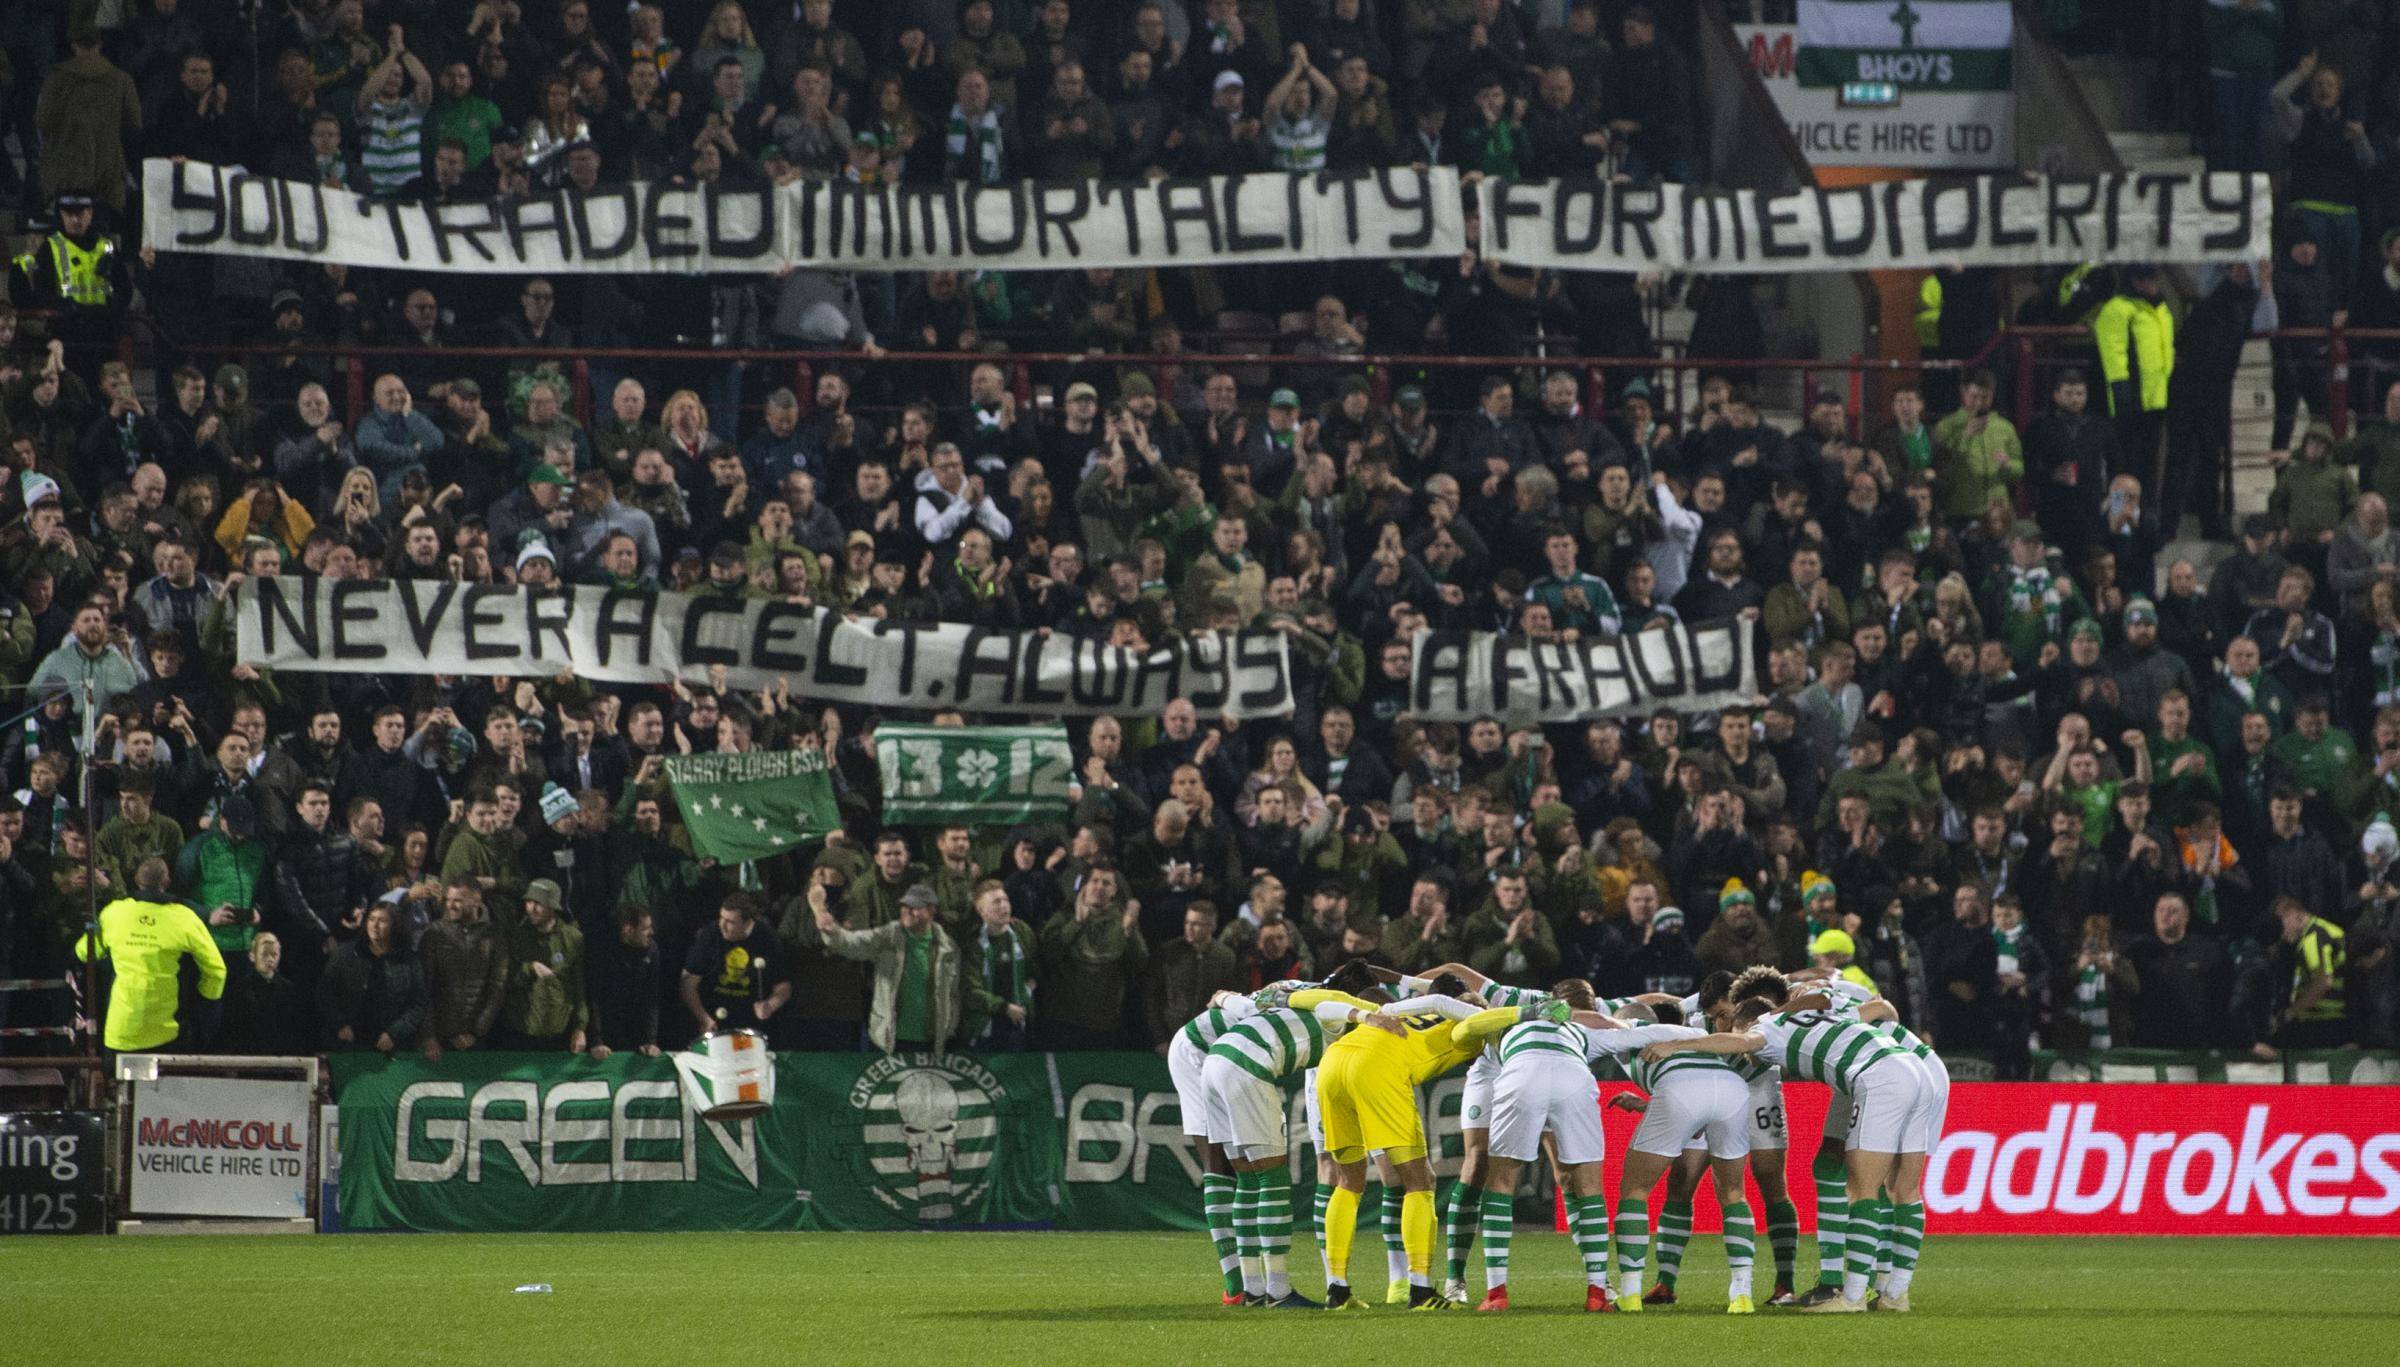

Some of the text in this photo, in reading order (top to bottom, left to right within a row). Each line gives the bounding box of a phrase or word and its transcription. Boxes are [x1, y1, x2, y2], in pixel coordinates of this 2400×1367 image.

[1858, 53, 1953, 83] BHOYS
[1797, 122, 1994, 154] ICLE HIRE LTD
[171, 162, 777, 263] YOU TRADED
[800, 166, 1435, 259] IMMORTALITY
[1490, 172, 2254, 262] FOR MEDIOCRITY
[256, 576, 575, 661] NEVER
[598, 586, 660, 666] A
[953, 625, 1290, 710] ALWAYS
[1415, 614, 1743, 711] A FRAUD
[664, 757, 724, 785] STARRY
[726, 750, 789, 784] PLOUGH
[876, 738, 1074, 799] 13 12
[849, 1050, 1008, 1110] GREEN BRIGADE
[138, 1116, 302, 1150] McNICOLL
[393, 1080, 760, 1189] GREEN
[1755, 1105, 1784, 1130] 63
[0, 1123, 79, 1181] ing
[138, 1153, 301, 1177] VEHICLE HIRE LTD
[1922, 1102, 2400, 1216] adbrokes
